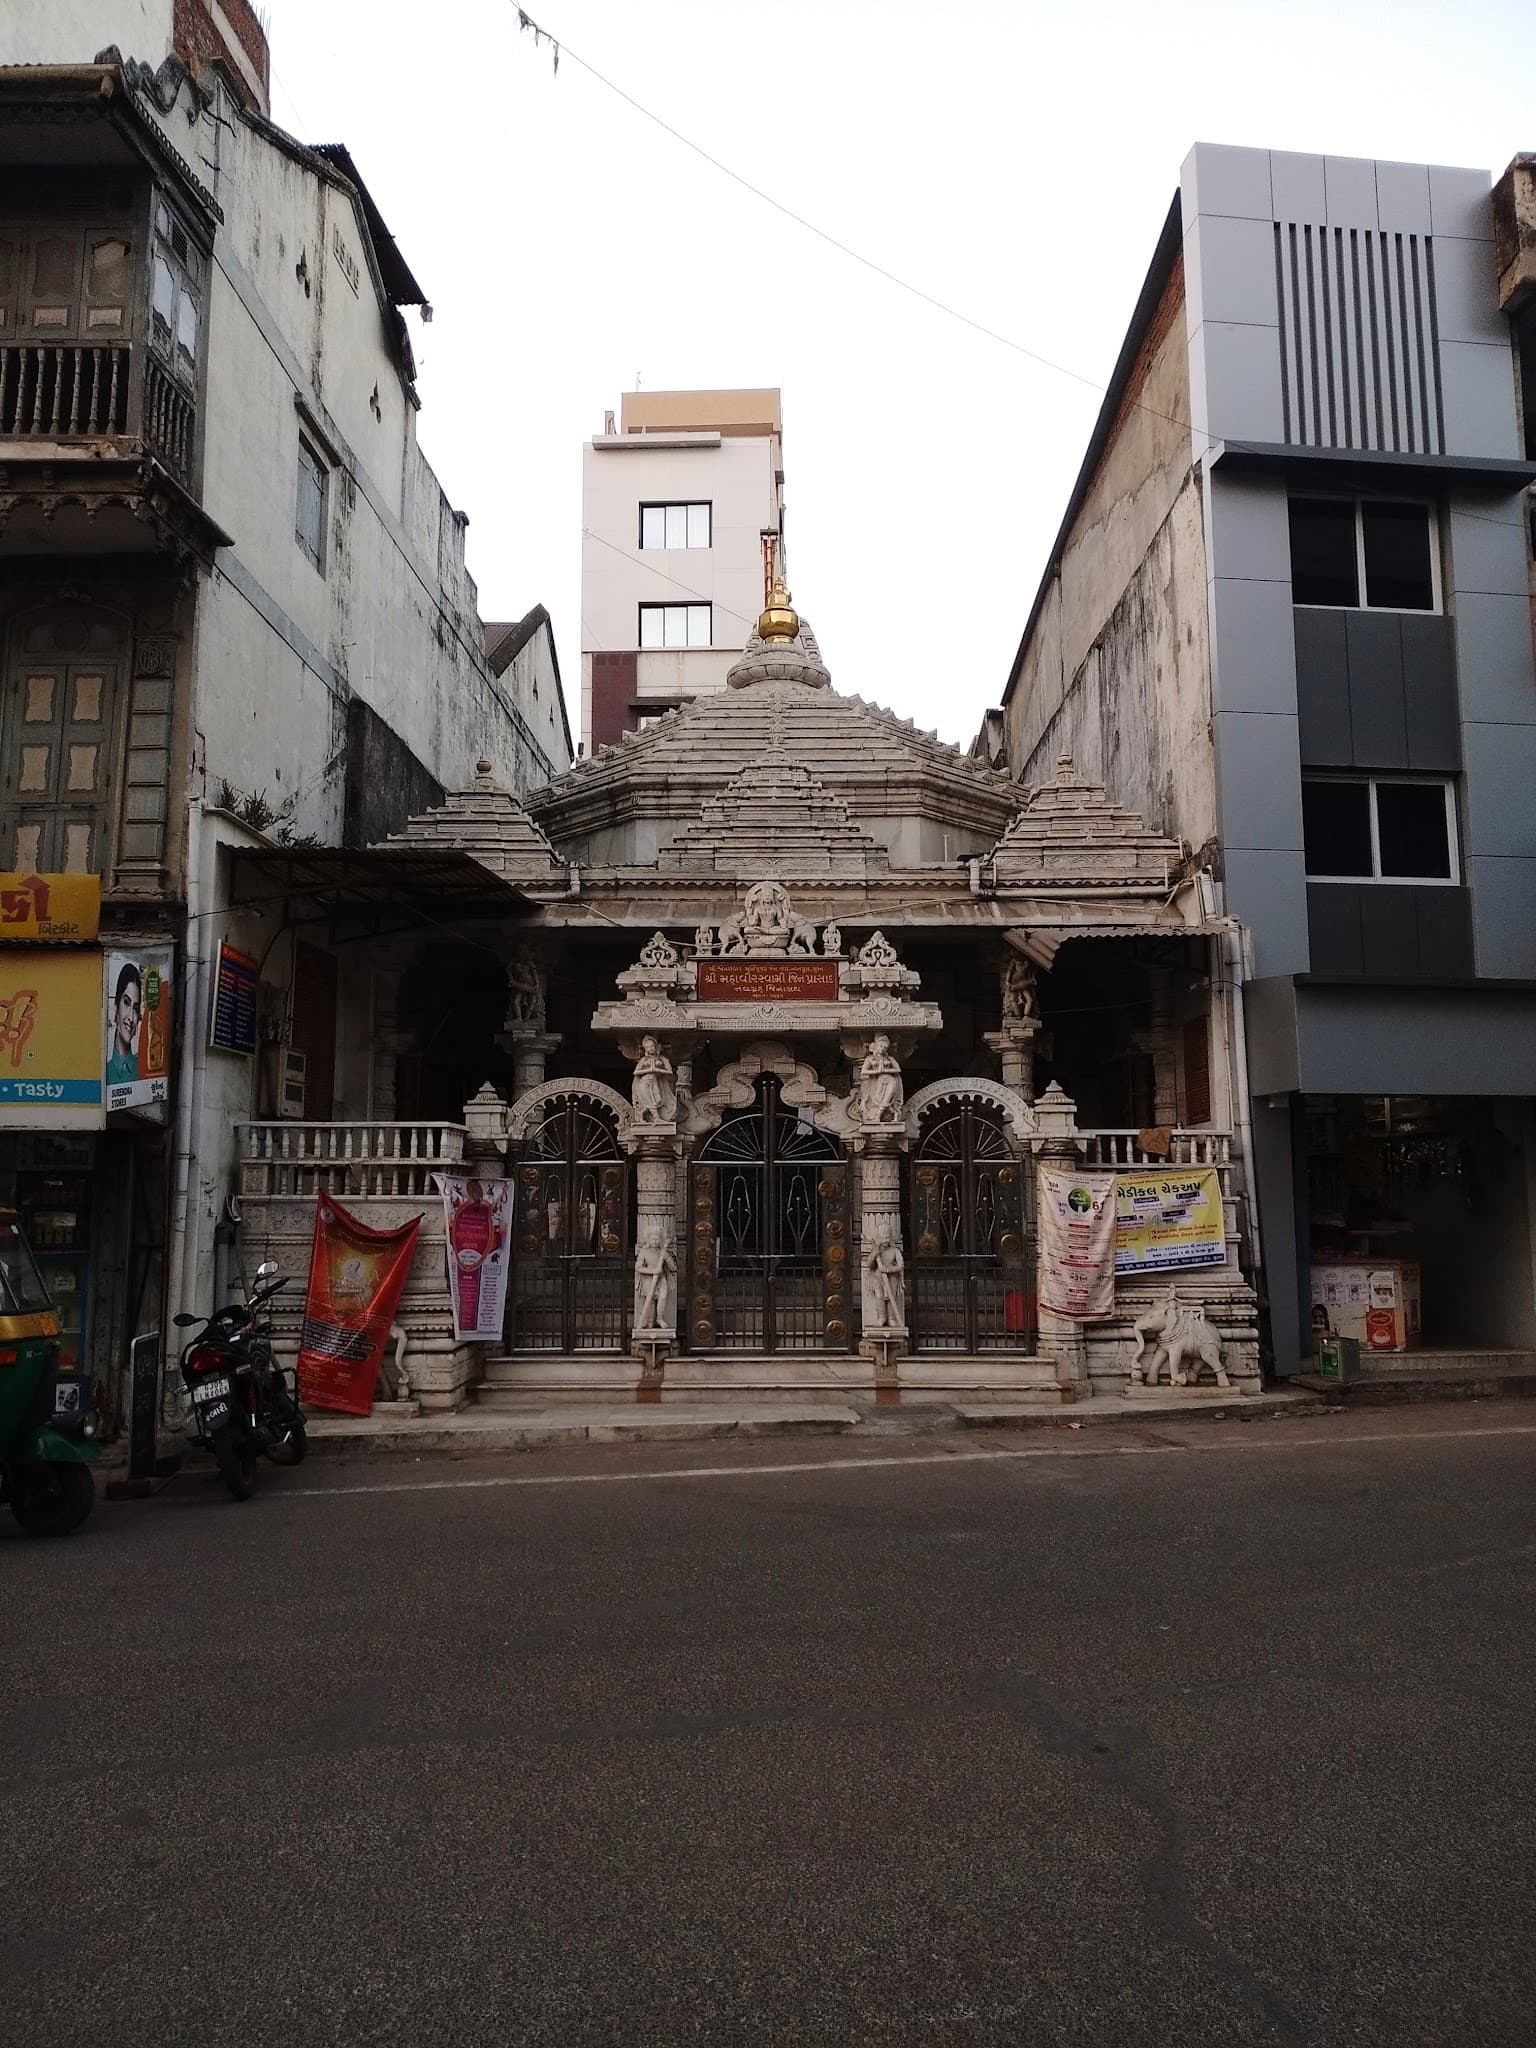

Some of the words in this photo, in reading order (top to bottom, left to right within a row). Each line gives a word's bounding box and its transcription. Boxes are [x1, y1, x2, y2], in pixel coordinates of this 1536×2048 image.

[704, 972, 717, 984] શ્રી
[720, 972, 786, 985] મહાવીરસ્વામી
[788, 972, 834, 985] જિનપ્રાસાદ
[14, 1082, 64, 1098] Tasty
[1116, 1186, 1157, 1199] મેડીકલ
